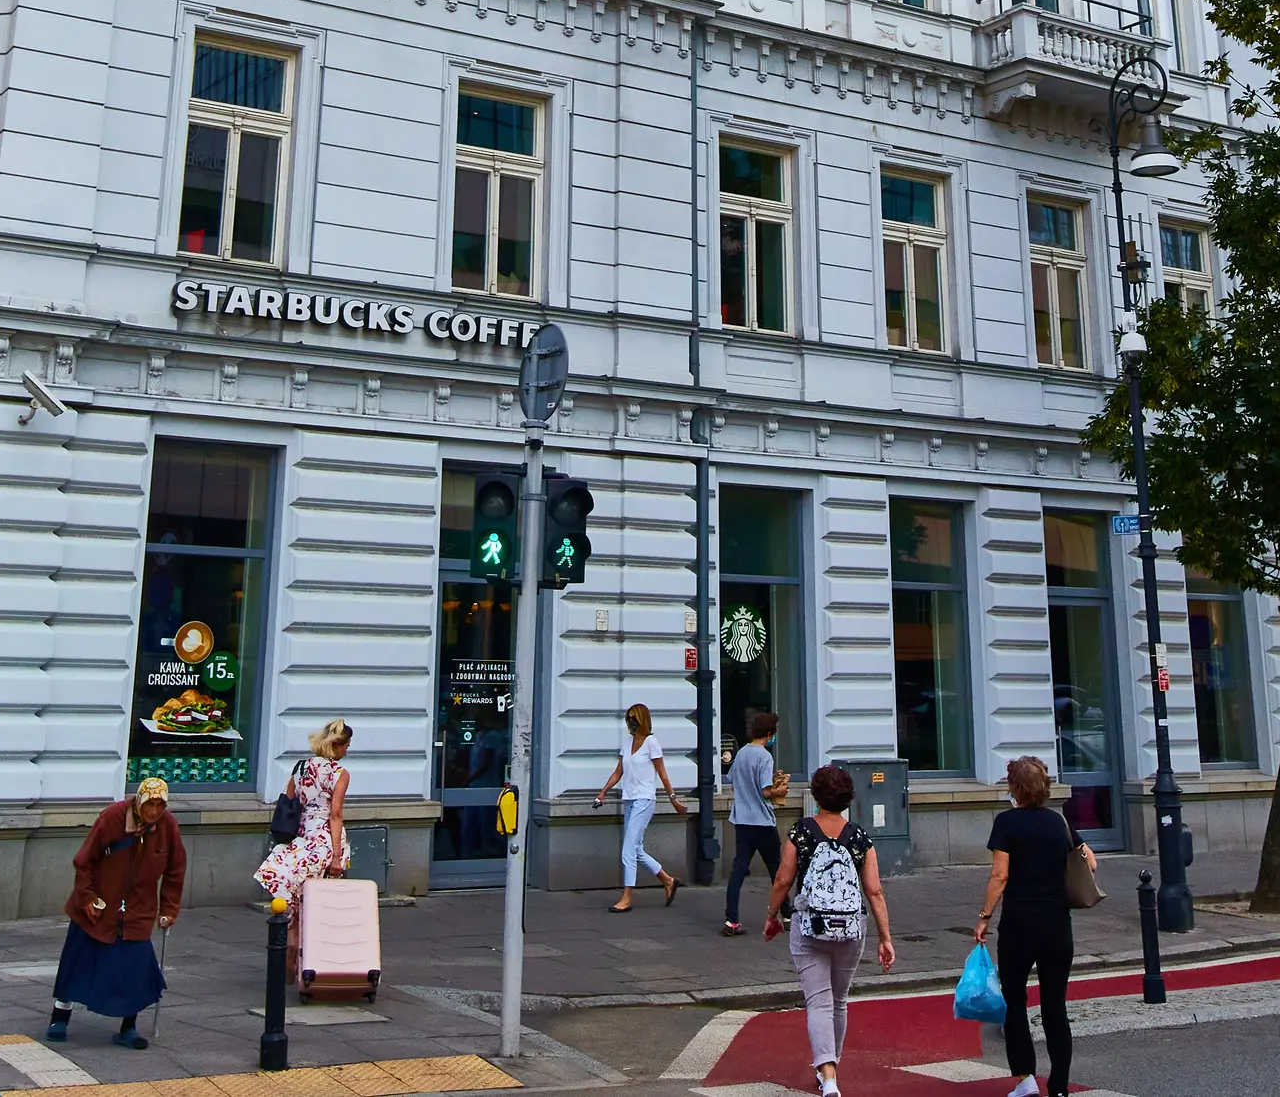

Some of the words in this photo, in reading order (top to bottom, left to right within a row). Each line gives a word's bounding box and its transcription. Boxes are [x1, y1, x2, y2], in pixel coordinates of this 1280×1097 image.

[173, 279, 414, 334] STARBUCKS
[426, 310, 541, 349] COFFE
[160, 662, 186, 674] KAWA
[206, 662, 227, 679] 15
[148, 673, 200, 686] CROISSANT
[455, 672, 486, 681] ZDOBYWAJ
[489, 673, 516, 681] NAGRODY
